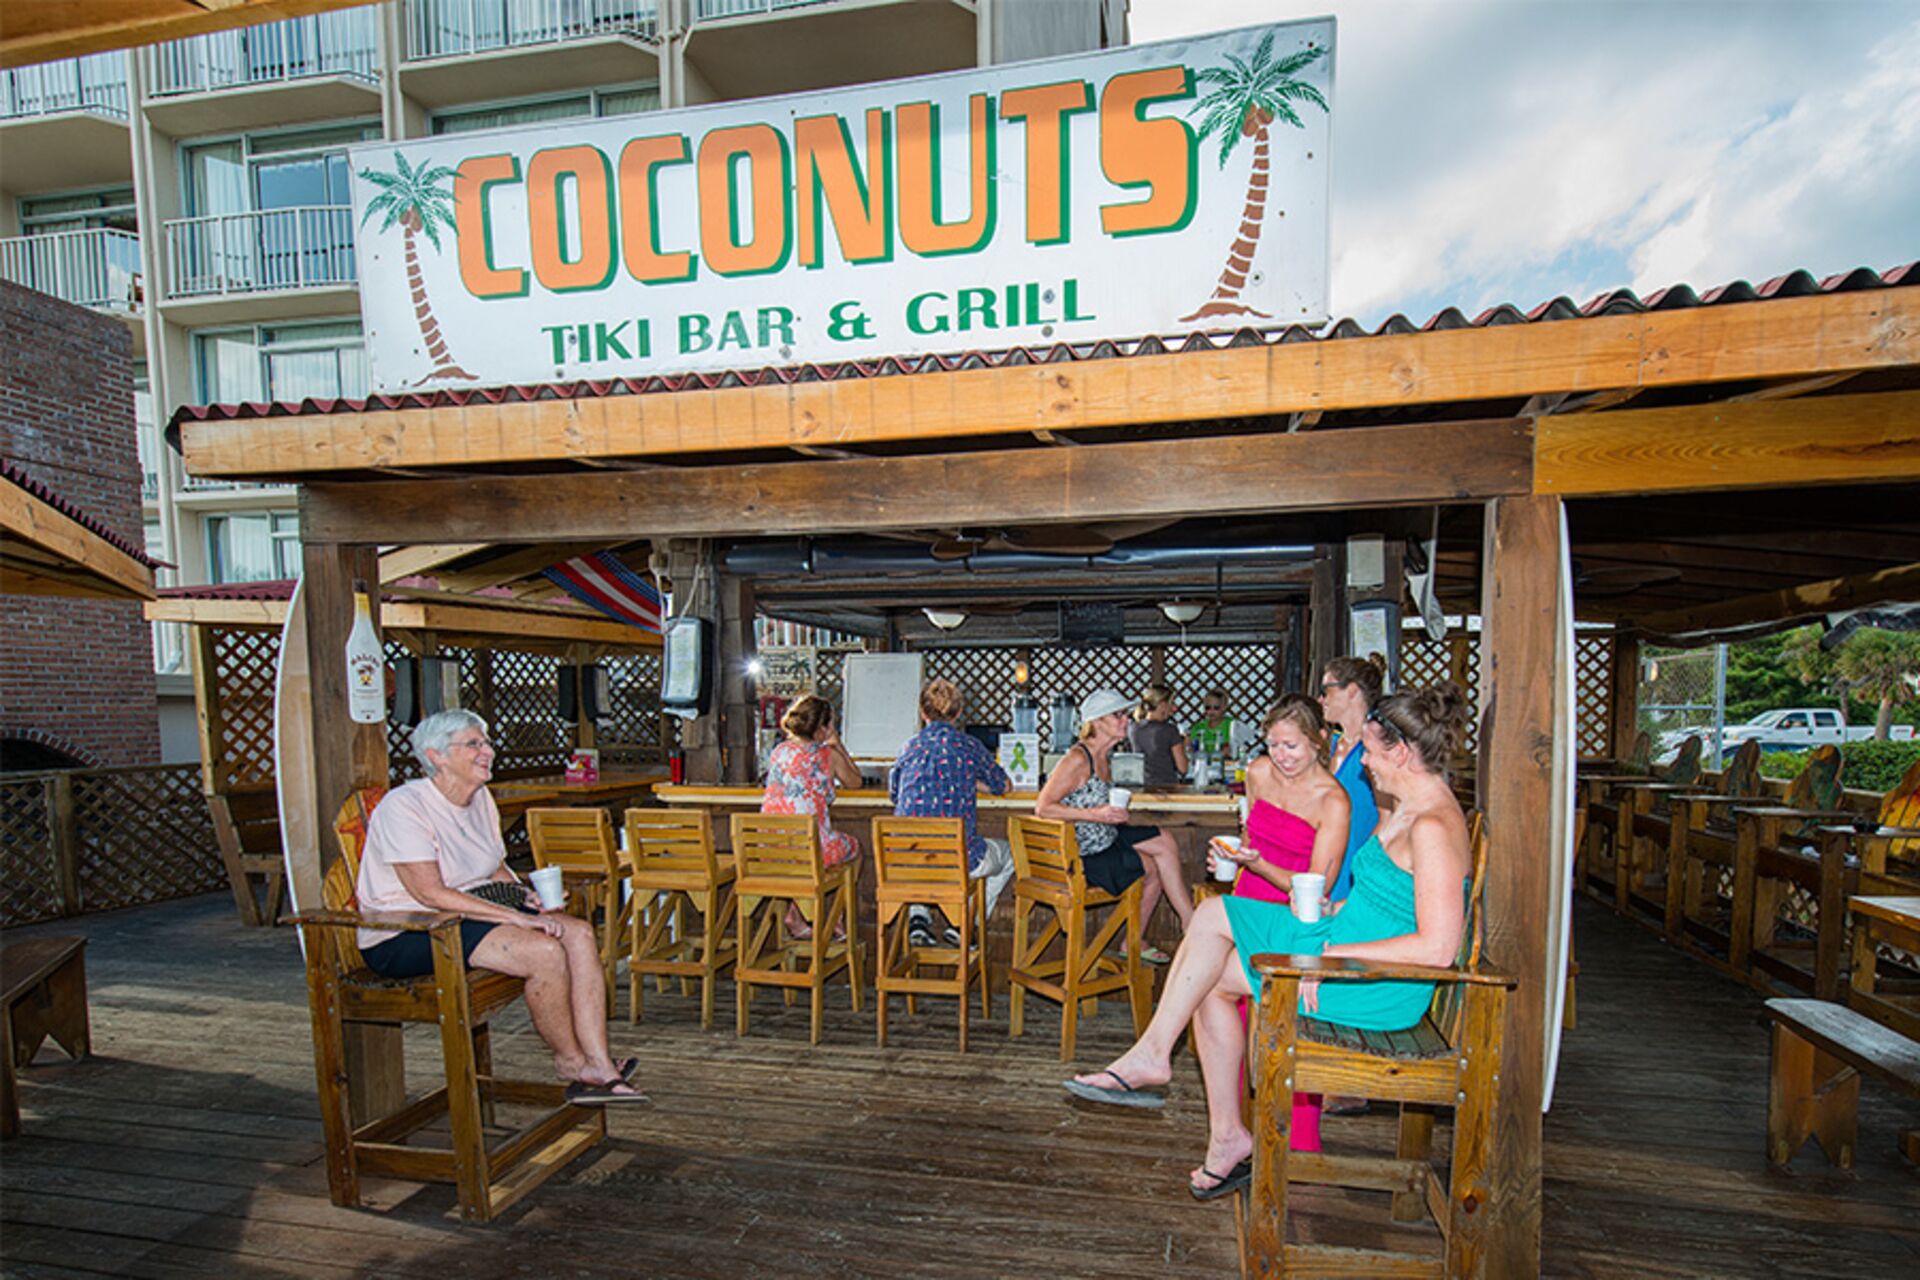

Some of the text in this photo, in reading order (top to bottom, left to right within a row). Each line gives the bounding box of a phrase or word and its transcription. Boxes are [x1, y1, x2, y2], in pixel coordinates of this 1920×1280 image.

[454, 63, 1200, 301] COCONUTS
[542, 279, 1097, 366] TIKI BAR & GRILL
